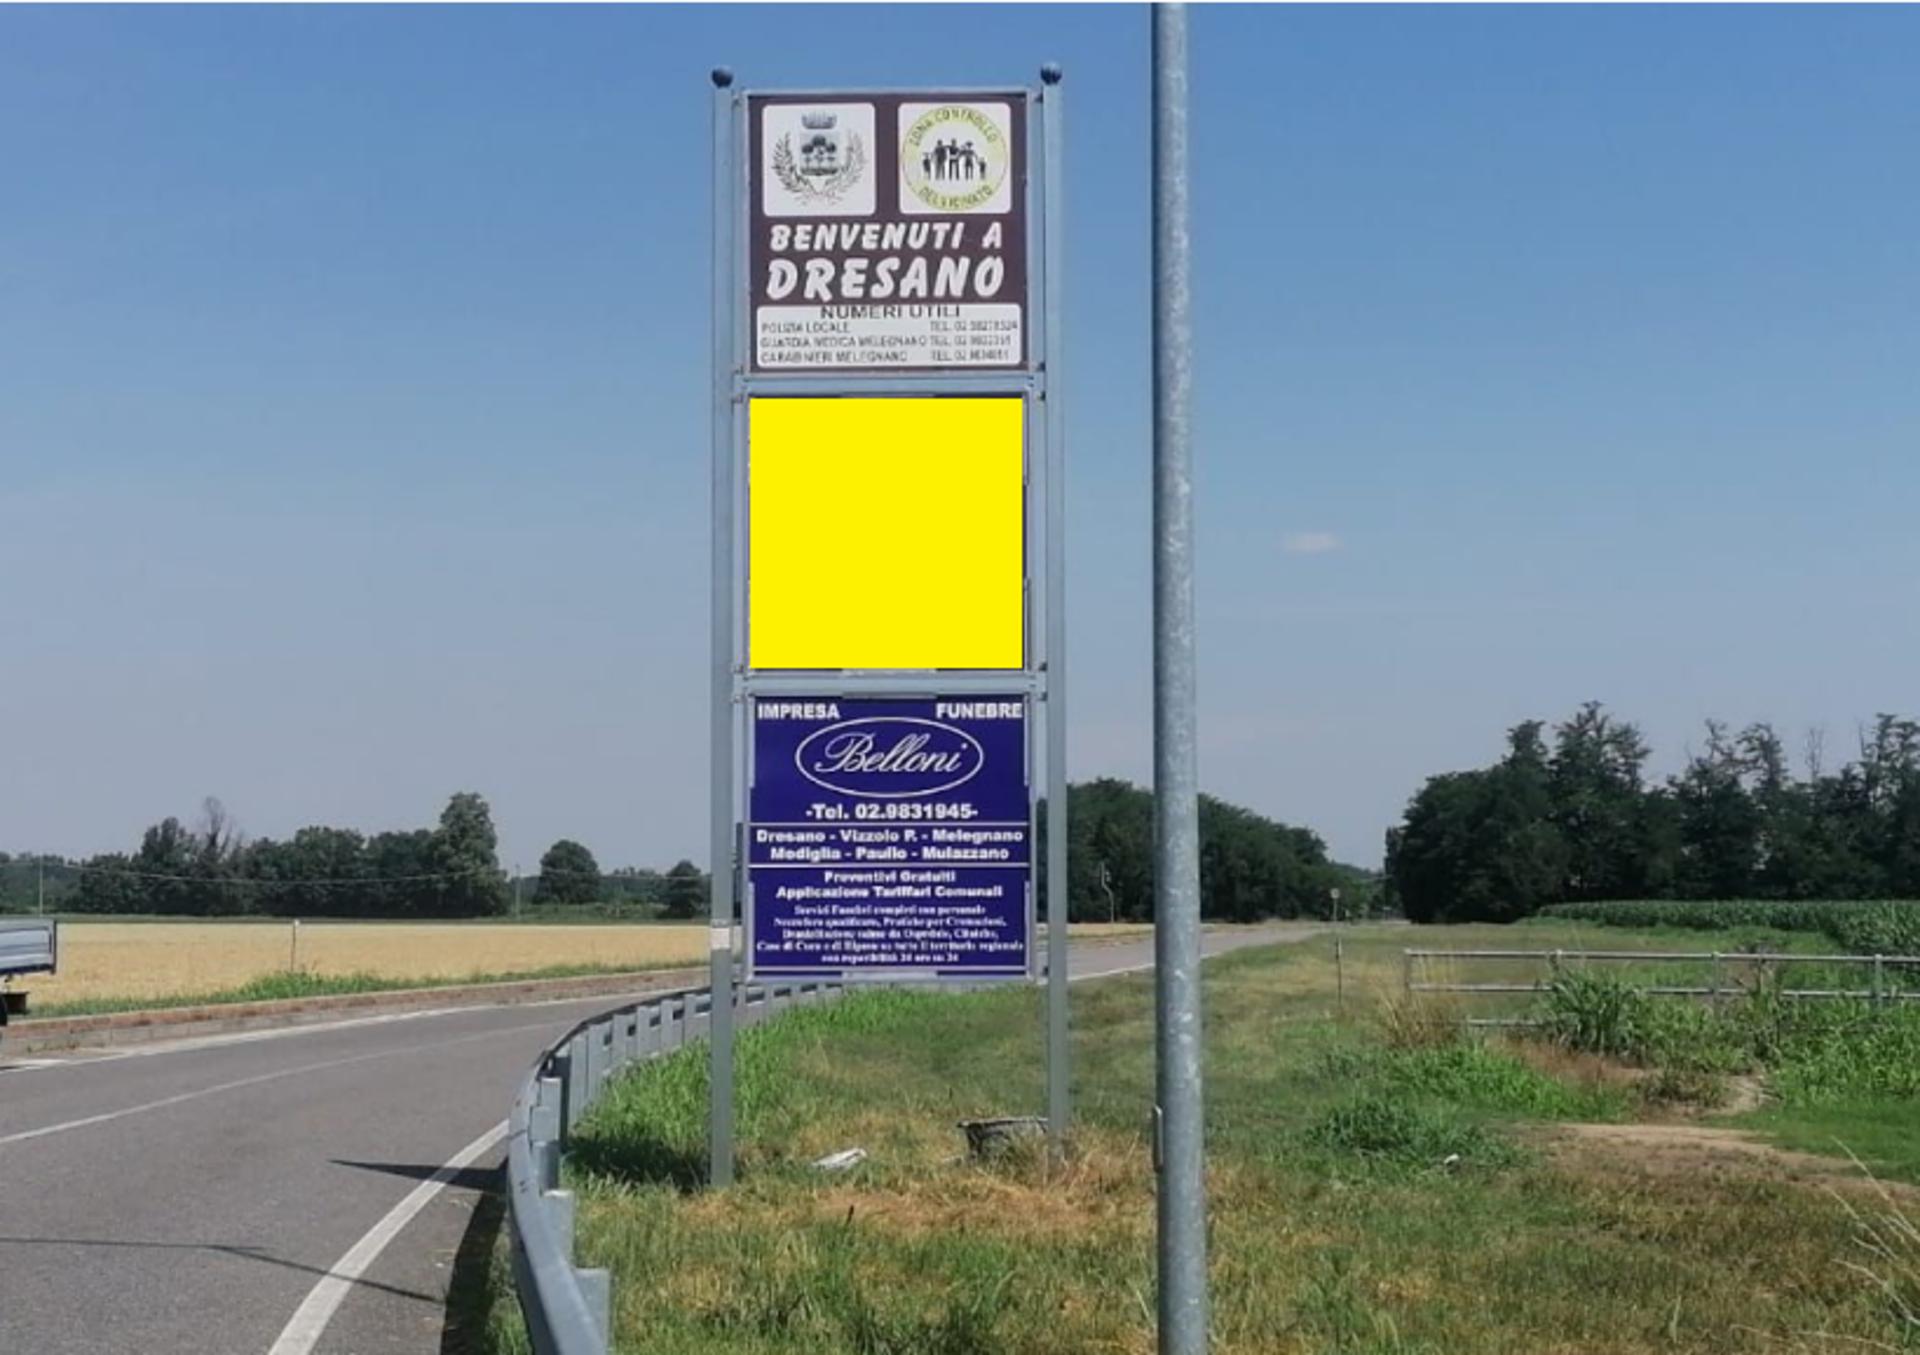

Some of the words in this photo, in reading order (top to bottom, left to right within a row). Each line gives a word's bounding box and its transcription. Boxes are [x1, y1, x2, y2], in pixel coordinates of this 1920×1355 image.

[770, 222, 964, 251] BENVENUTI
[982, 222, 1002, 249] A
[766, 256, 1004, 301] DRESANO
[821, 306, 902, 320] NUMERI
[909, 305, 960, 318] UTILI
[806, 321, 850, 334] LOCALE
[757, 703, 840, 719] IMPRESA
[936, 703, 1023, 719] FUNEBRE
[814, 732, 969, 773] Belloni
[756, 829, 826, 843] Dresano
[839, 829, 900, 843] Vizzolo
[904, 828, 918, 842] P.
[932, 828, 1024, 845] Melegnano
[770, 846, 841, 862] Mediglia
[855, 846, 908, 860] Paullo
[921, 845, 1009, 860] Mulazzano
[824, 870, 897, 883] Preventivi
[900, 869, 956, 883] Gratuiti
[776, 885, 870, 901] Applicazione
[934, 885, 1003, 898] Comunali
